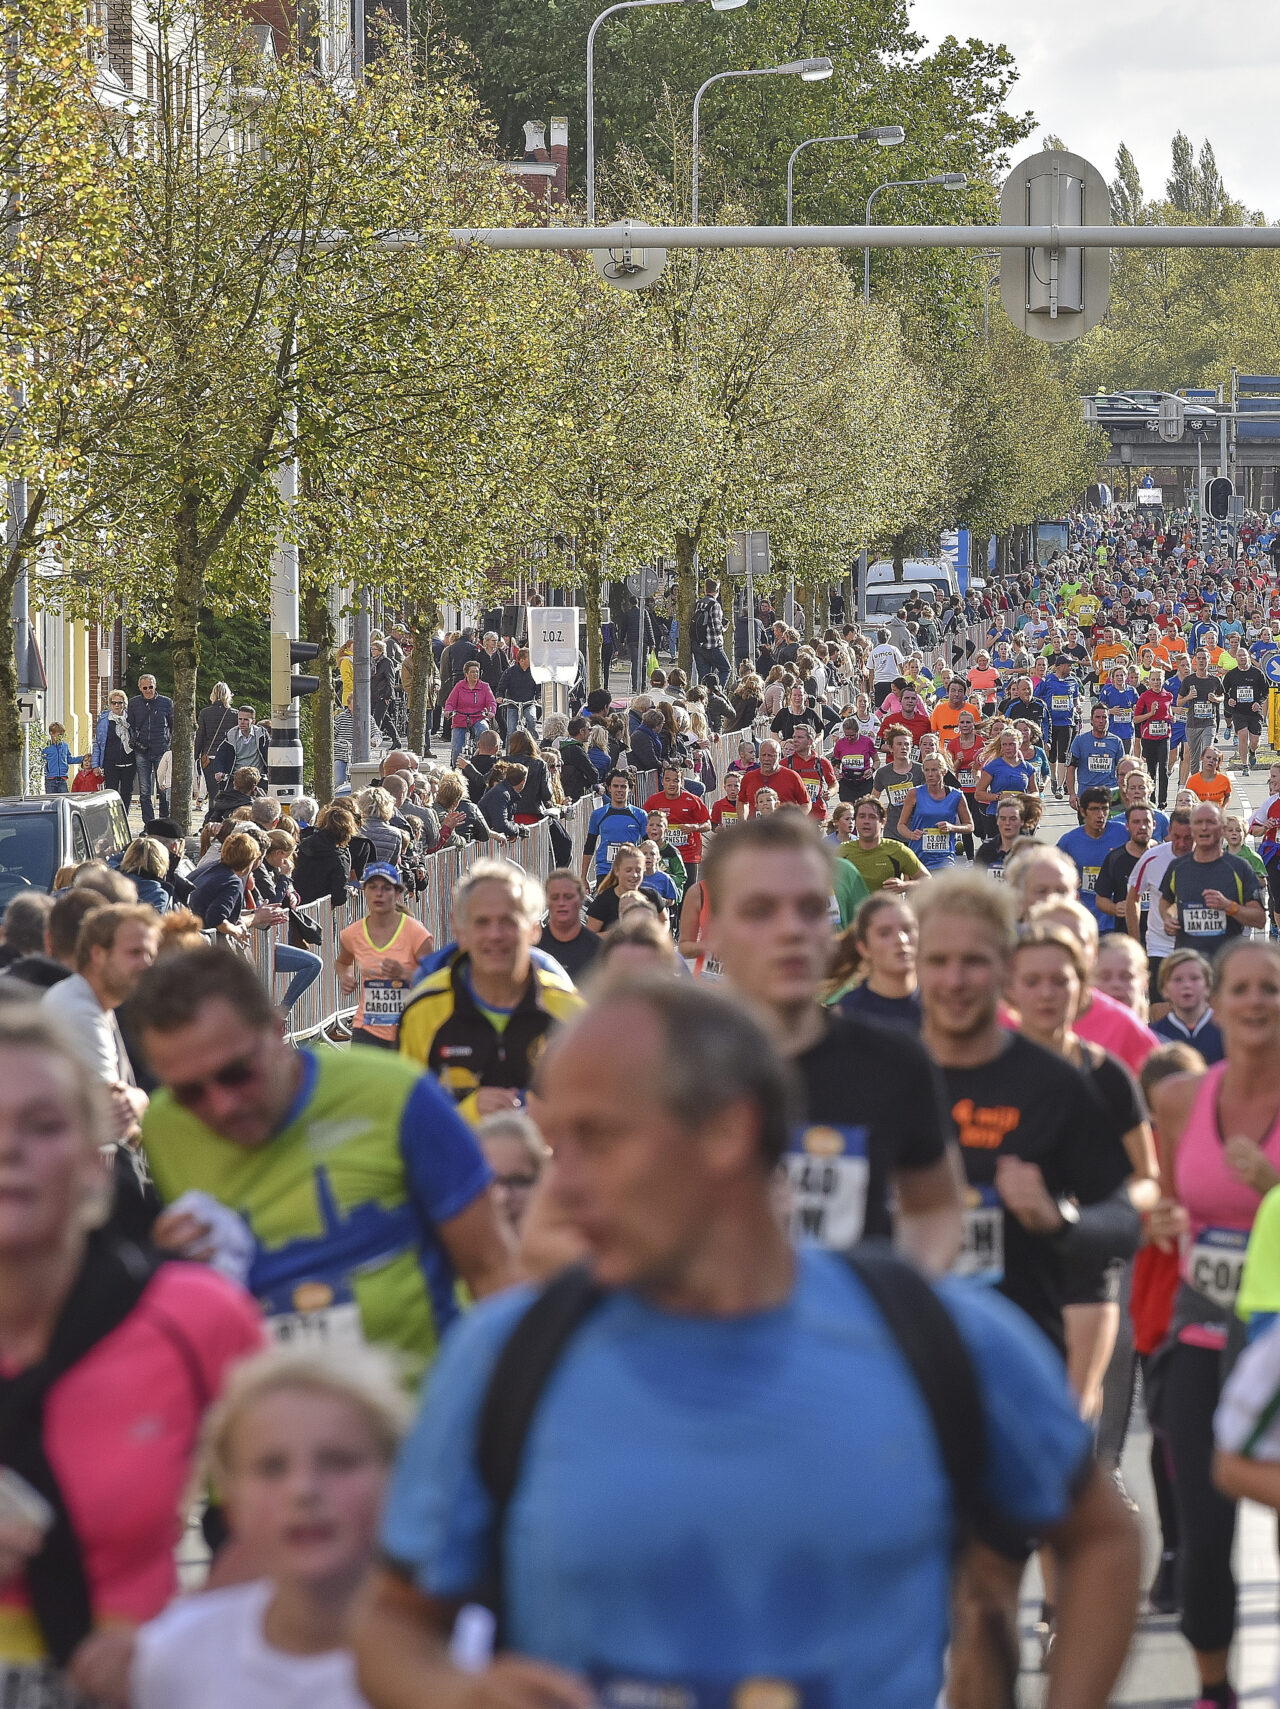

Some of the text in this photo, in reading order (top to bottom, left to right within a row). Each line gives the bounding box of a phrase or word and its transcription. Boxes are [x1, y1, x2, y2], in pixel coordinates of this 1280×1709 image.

[542, 630, 565, 642] Z.O.Z.
[1189, 910, 1219, 921] 14.059
[1187, 921, 1202, 931] JAN
[371, 990, 401, 1001] 14.531
